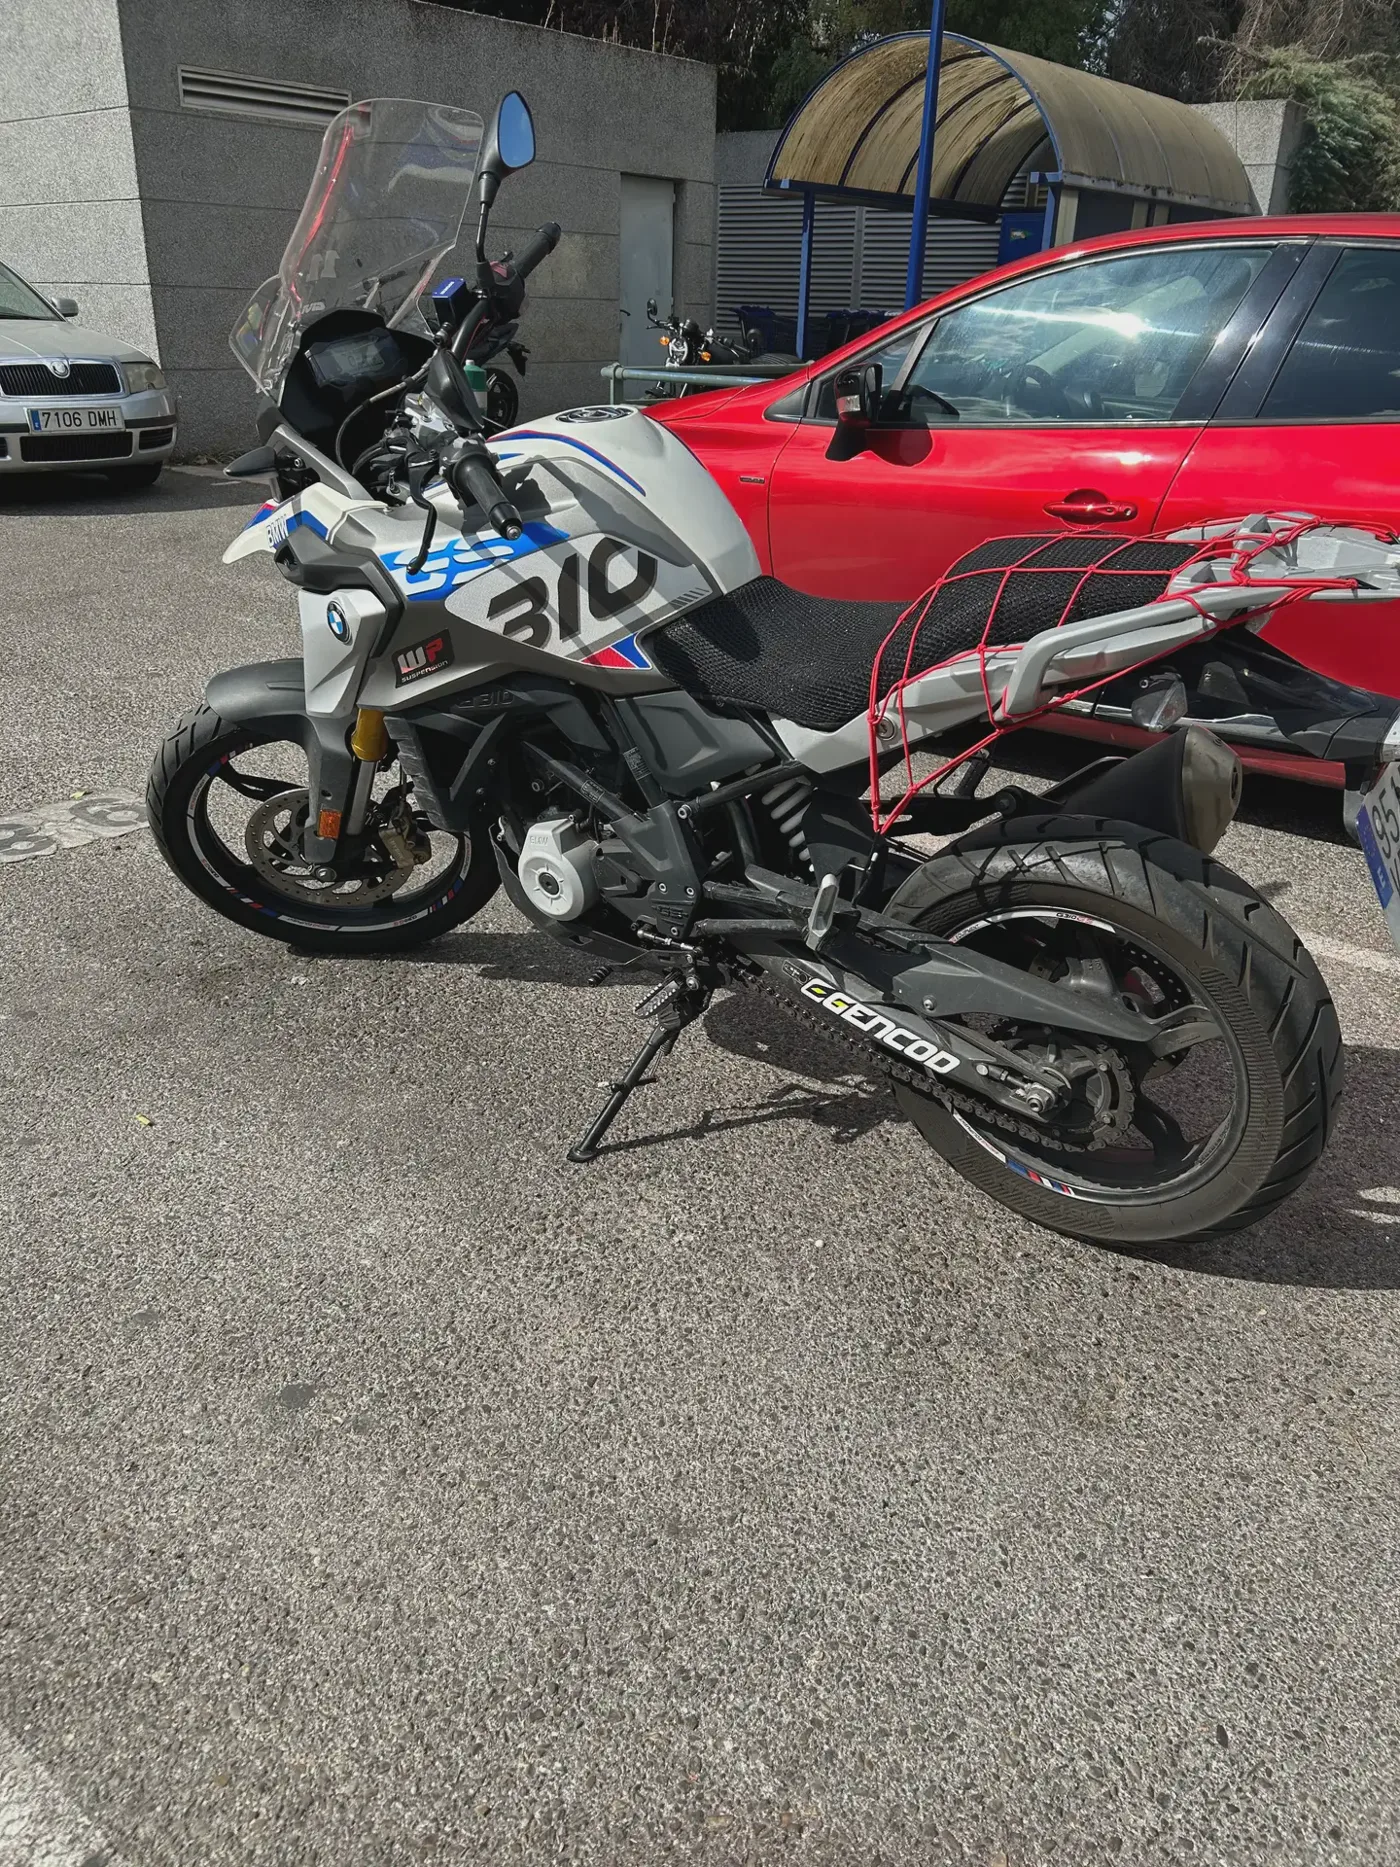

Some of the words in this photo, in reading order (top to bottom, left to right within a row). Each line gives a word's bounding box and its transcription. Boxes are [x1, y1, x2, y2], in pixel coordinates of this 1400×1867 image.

[41, 411, 82, 428] 7106
[88, 410, 117, 427] DMH
[266, 514, 289, 548] BMW
[486, 535, 658, 648] 310
[397, 637, 443, 674] WP
